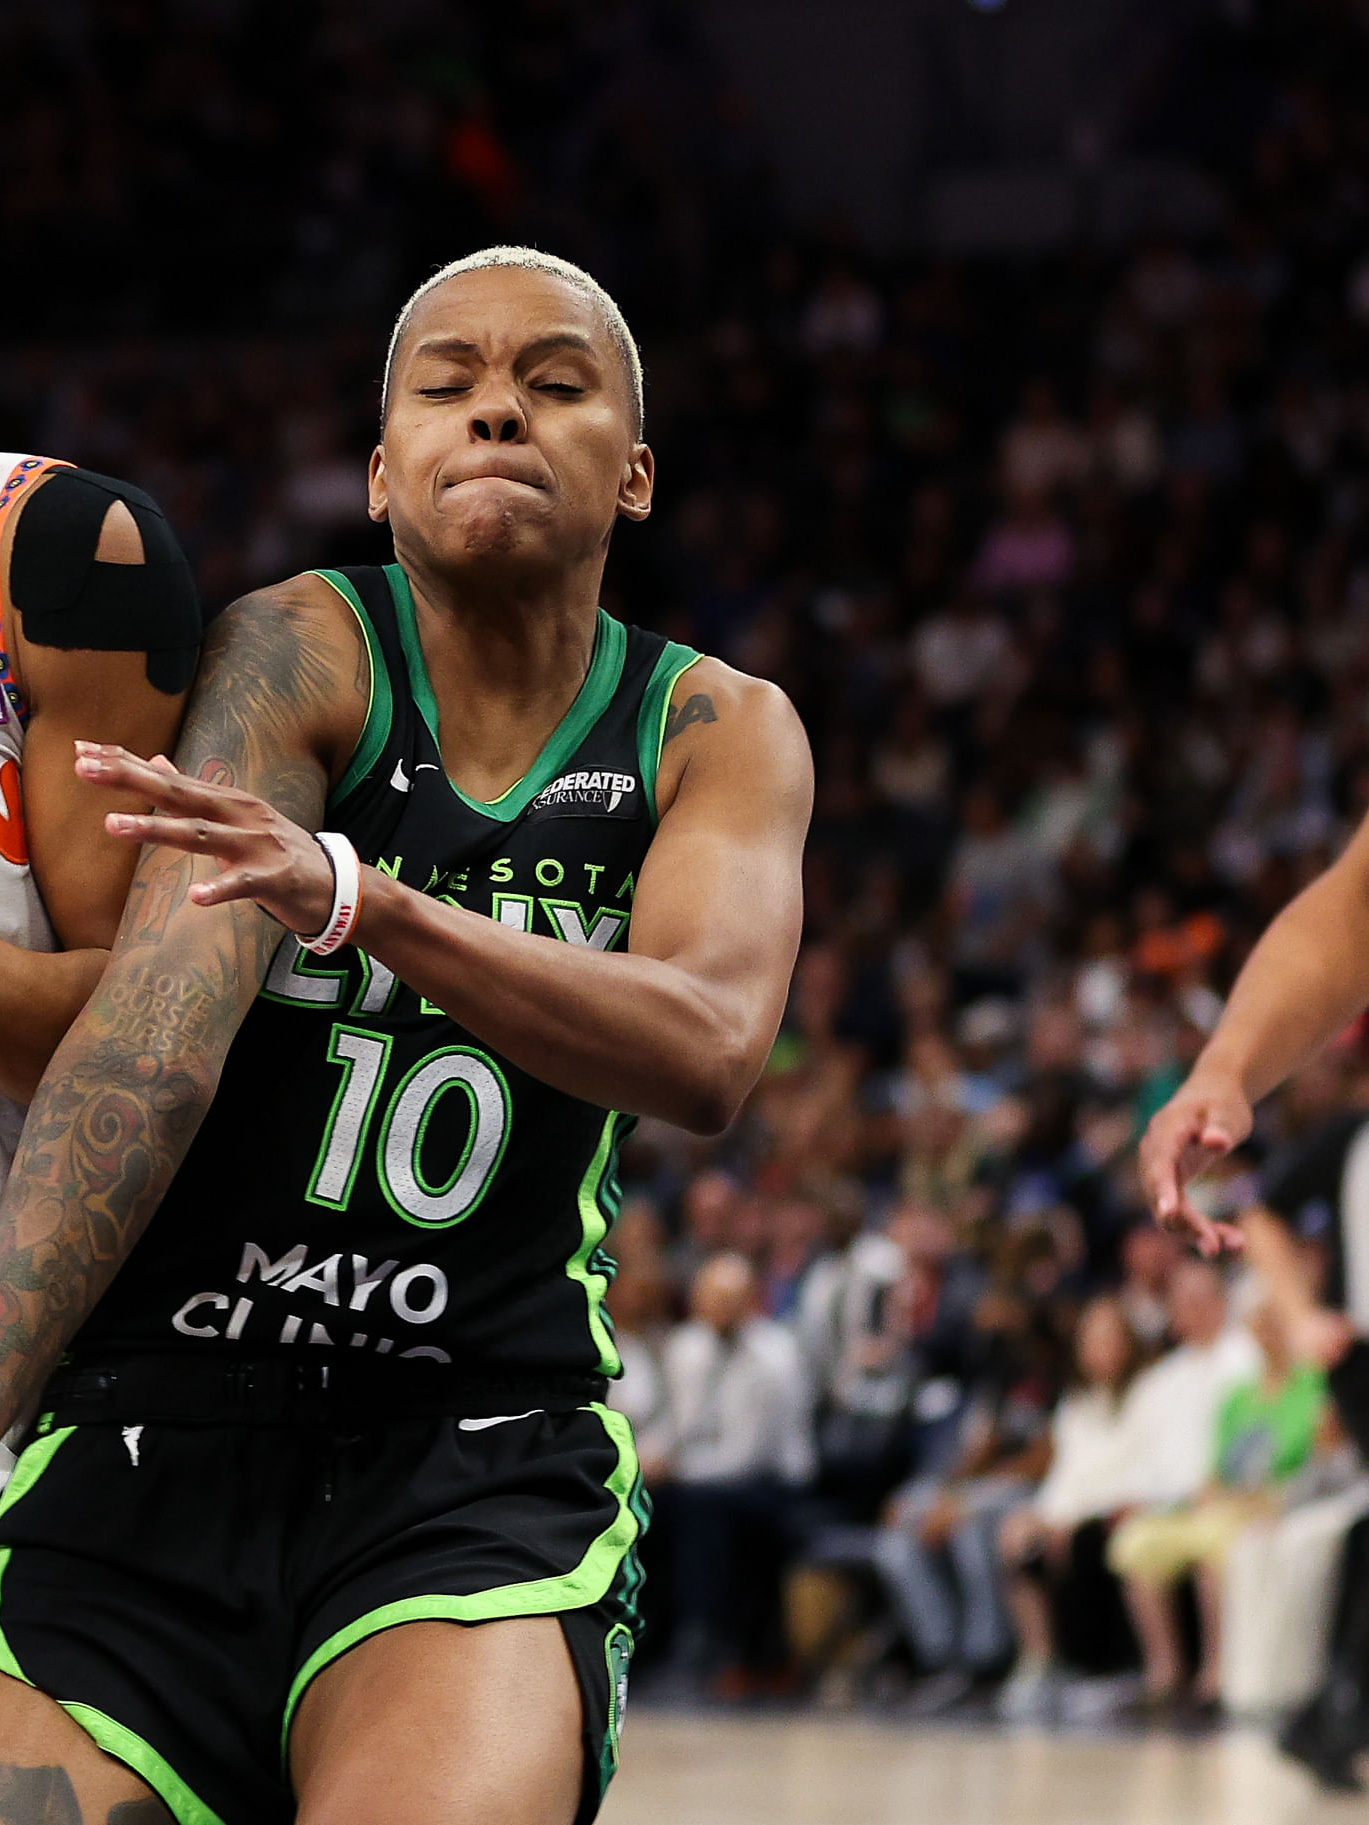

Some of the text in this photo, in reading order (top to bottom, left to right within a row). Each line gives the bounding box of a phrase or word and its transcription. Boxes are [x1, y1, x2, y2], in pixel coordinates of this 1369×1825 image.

[540, 771, 636, 800] EDERATED
[304, 1023, 513, 1230] 10
[236, 1242, 448, 1324] MAYO
